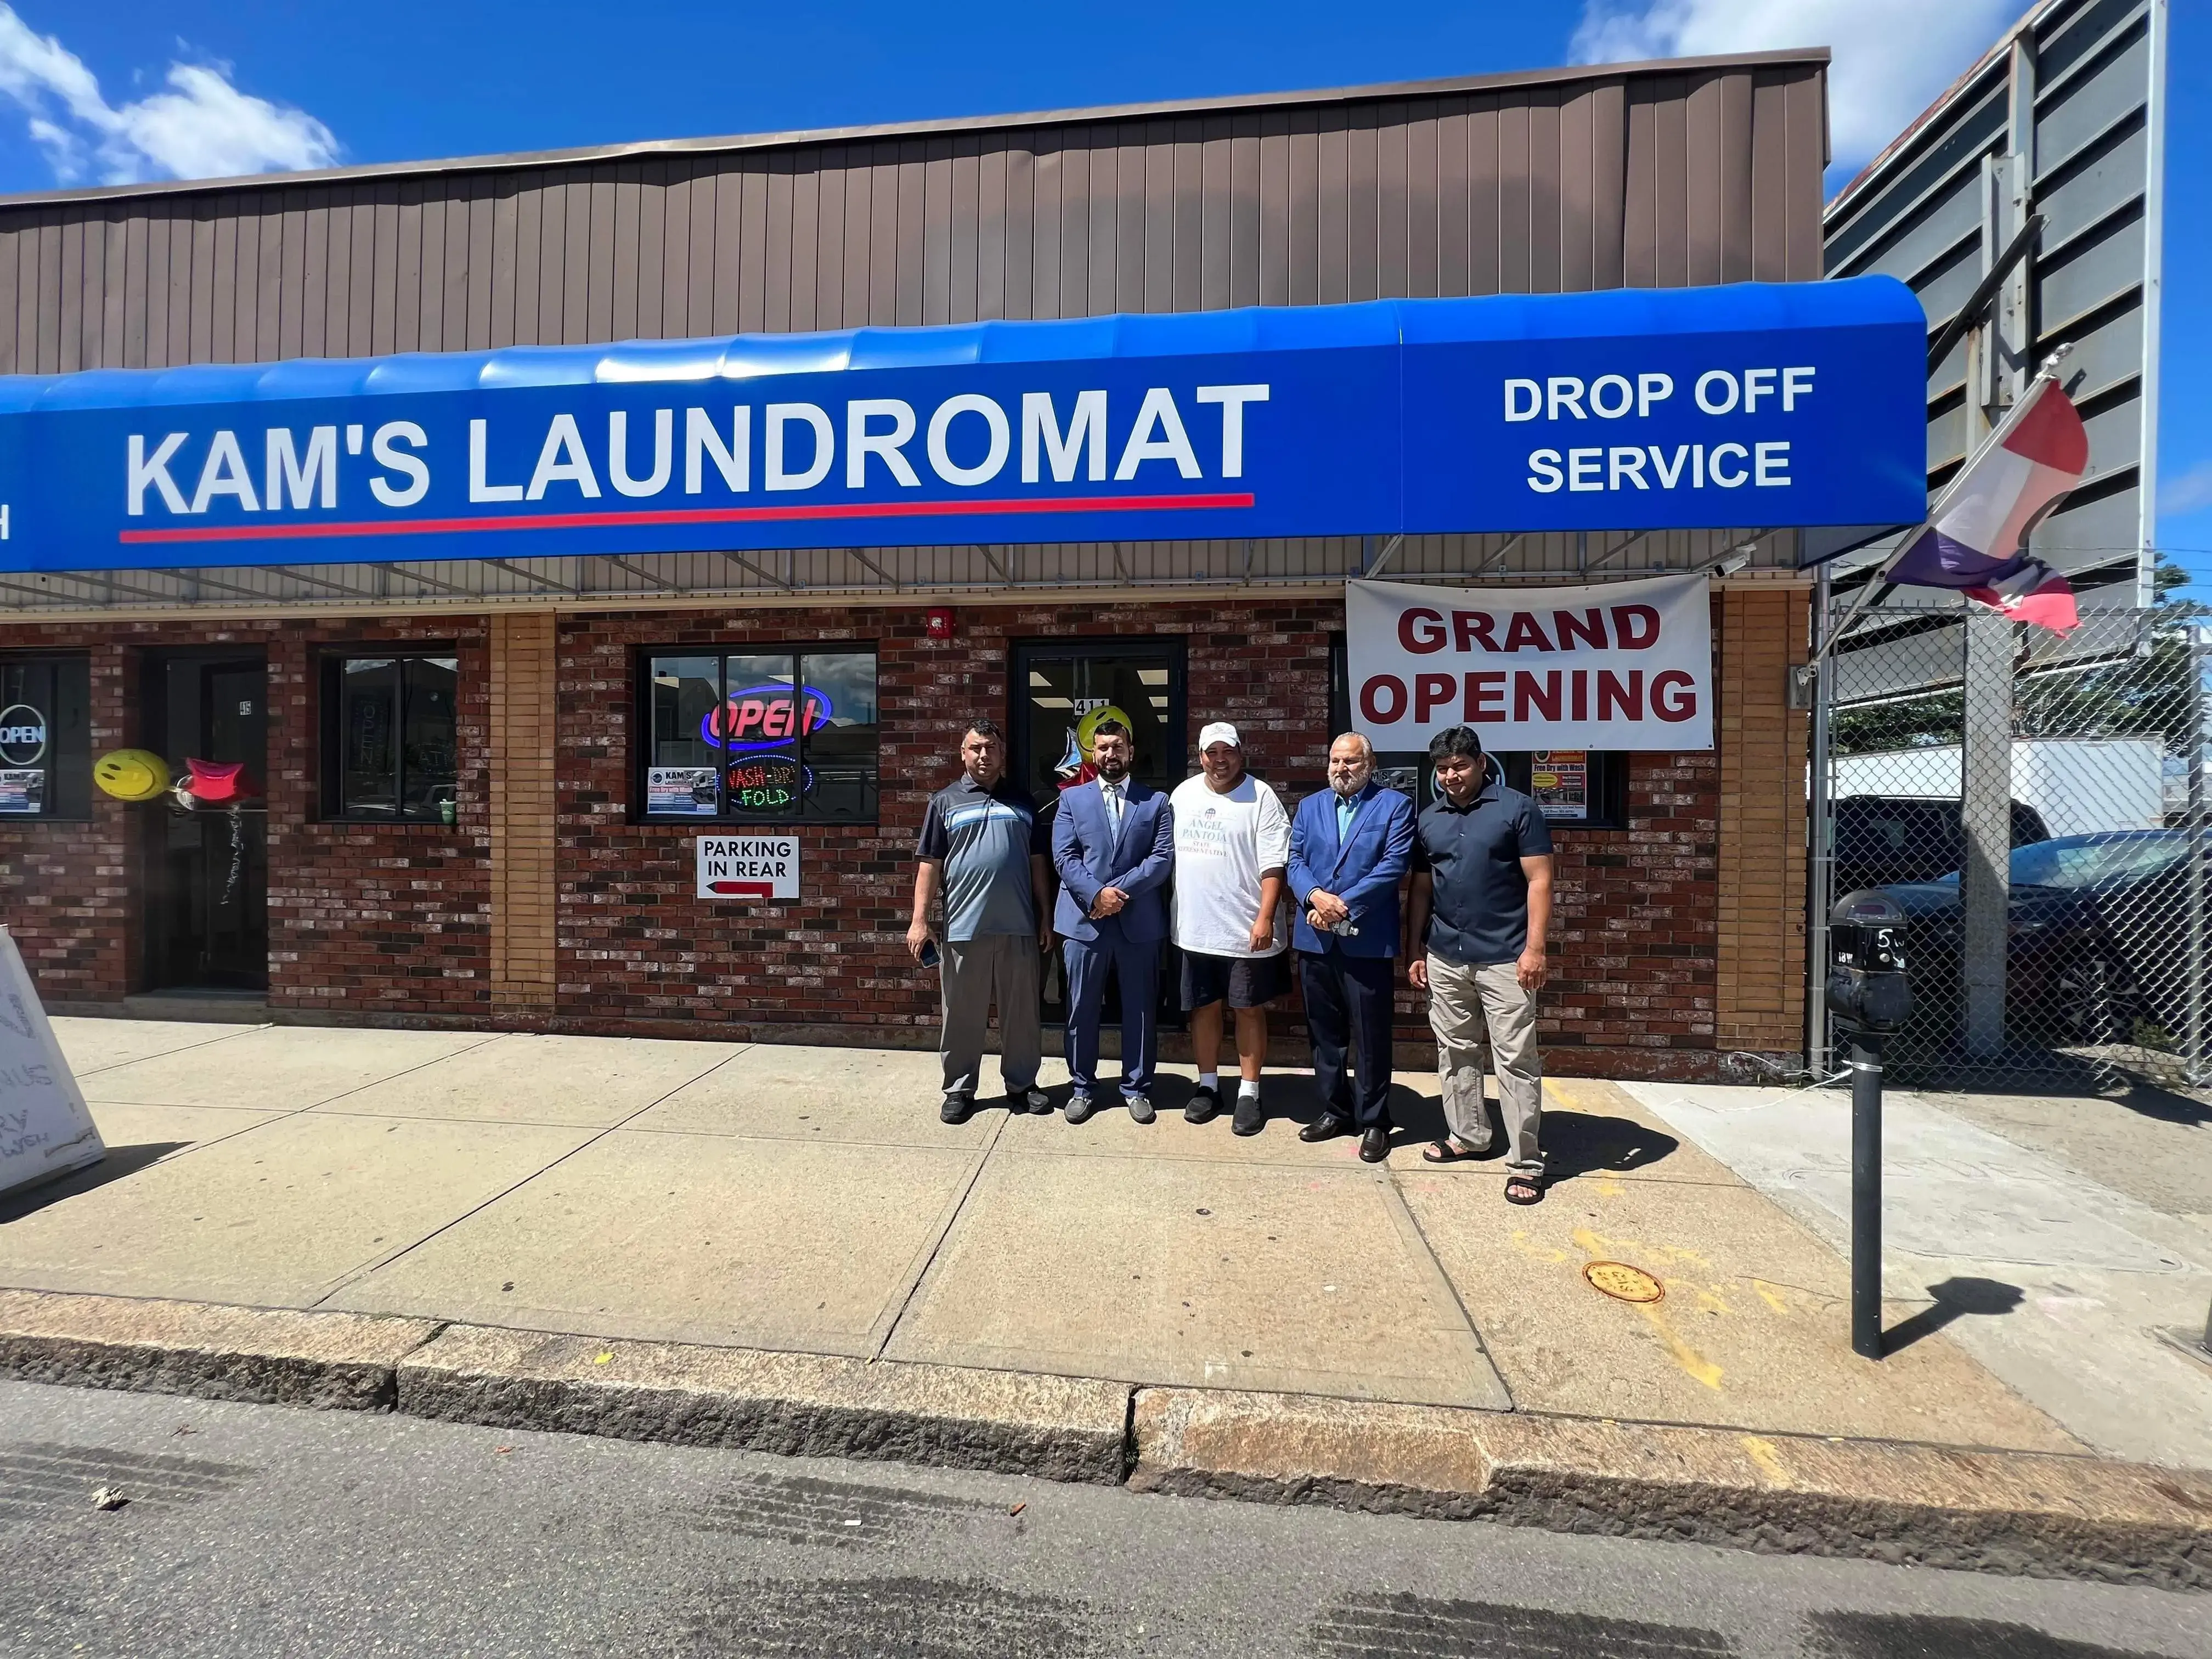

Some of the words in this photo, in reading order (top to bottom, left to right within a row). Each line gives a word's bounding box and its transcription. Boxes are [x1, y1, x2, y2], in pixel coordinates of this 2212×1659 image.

[1505, 373, 1673, 422] DROP
[1695, 366, 1815, 415] OFF
[128, 421, 430, 515] KAM'S
[470, 384, 1270, 503] LAUNDROMAT
[1527, 442, 1791, 493] SERVICE
[1397, 604, 1661, 654] GRAND
[1359, 669, 1697, 725] OPENING
[0, 726, 46, 743] OPEN
[710, 699, 816, 736] OPEN
[741, 789, 789, 805] FOLD
[1189, 818, 1223, 831] ANGEL
[704, 841, 791, 857] PARKING
[708, 861, 727, 876] IN
[736, 861, 787, 877] REAR
